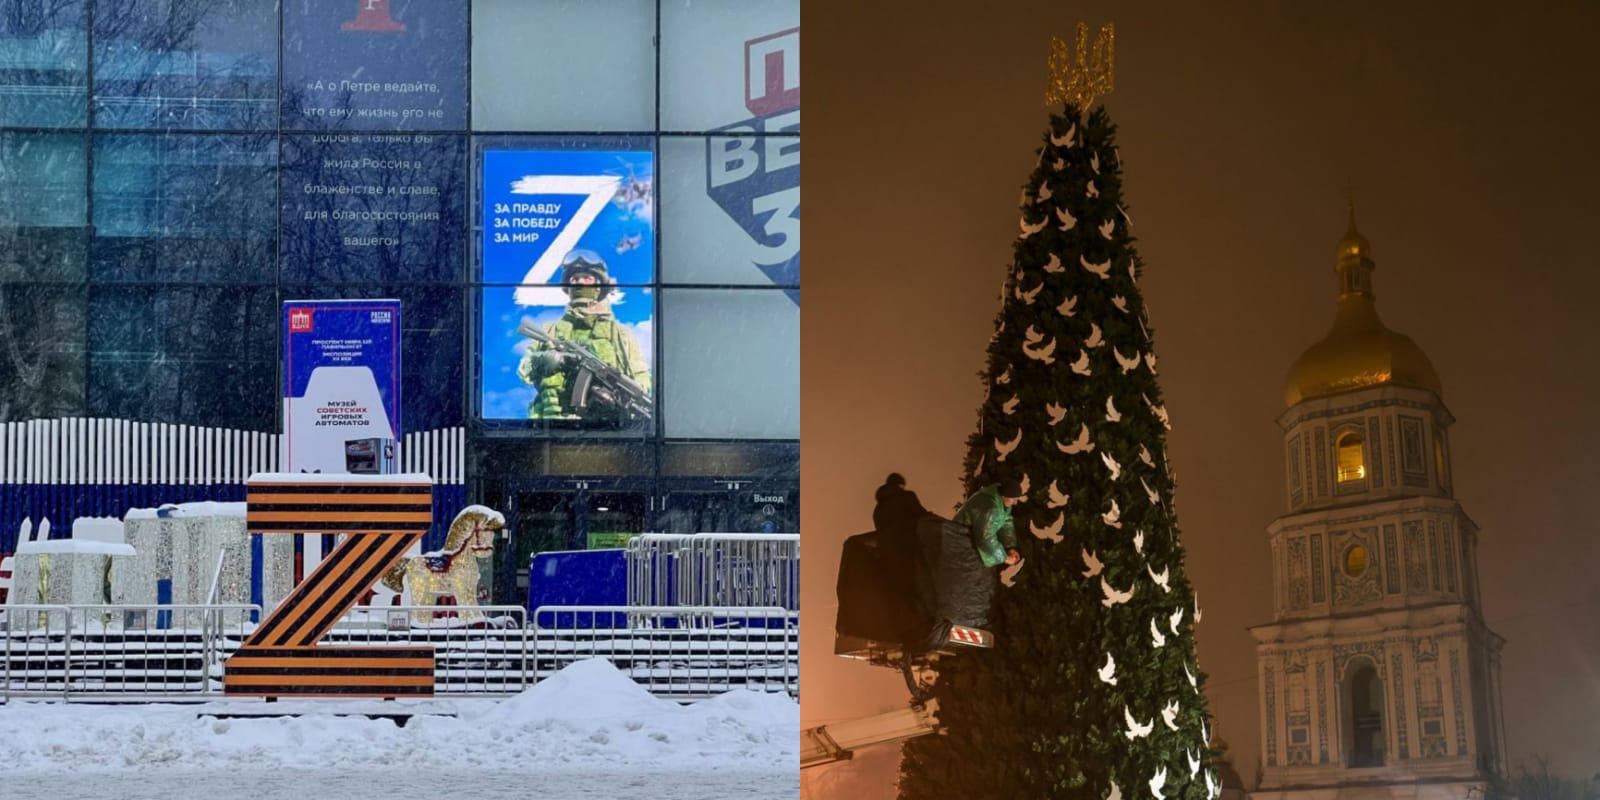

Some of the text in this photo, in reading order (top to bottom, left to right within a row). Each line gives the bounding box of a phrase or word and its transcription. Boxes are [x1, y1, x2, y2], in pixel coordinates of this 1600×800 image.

[306, 80, 441, 95] «А о Петре ведайте,
[302, 108, 444, 120] что ему жизнь его не
[323, 158, 422, 169] жила Россия в
[304, 183, 441, 196] блаженстве и славе,
[494, 203, 562, 215] ЗА ПРАВДУ
[304, 208, 440, 222] для благосостояния
[494, 218, 562, 229] ЗА ПОБЕДУ
[344, 236, 399, 246] вашего»
[494, 233, 540, 243] ЗА МИР
[753, 494, 784, 504] Выход
